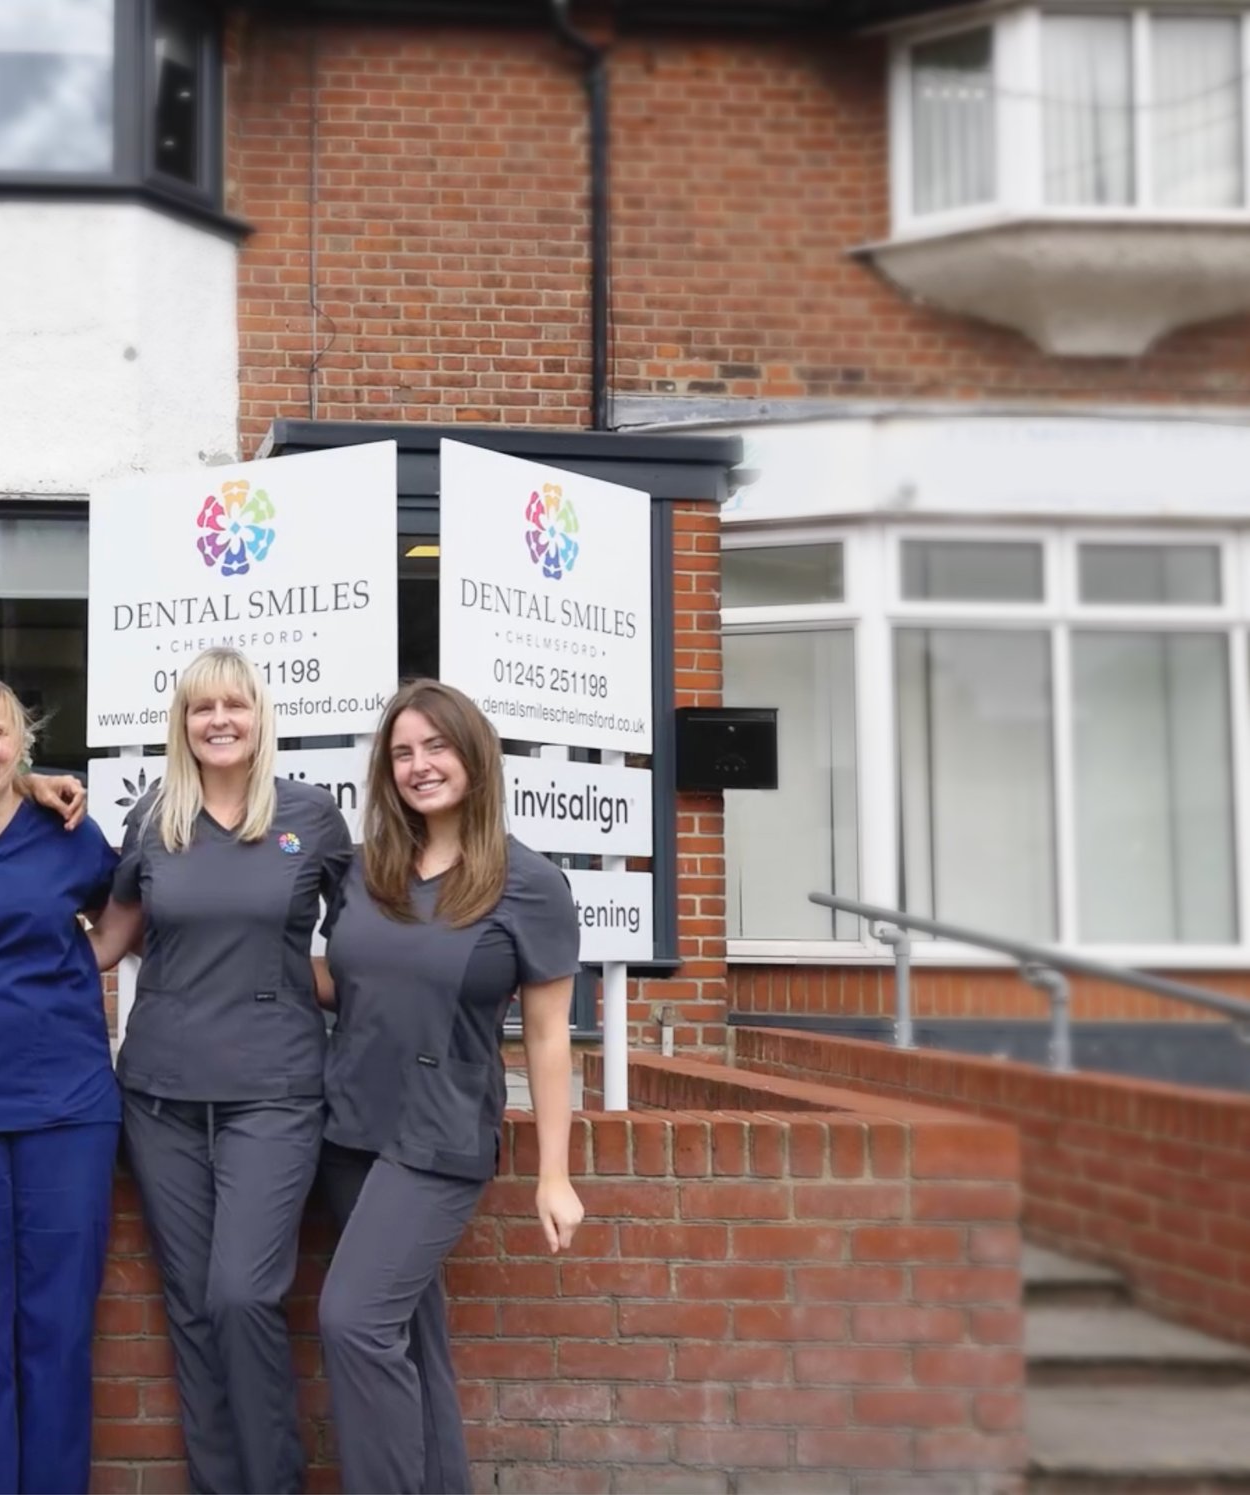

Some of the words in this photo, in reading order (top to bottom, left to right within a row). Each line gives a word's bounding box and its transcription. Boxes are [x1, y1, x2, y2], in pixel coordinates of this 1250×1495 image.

[113, 594, 240, 631] DENTAL
[248, 580, 370, 619] SMILES
[461, 578, 556, 624] DENTAL
[561, 599, 636, 638] SMILES
[506, 630, 597, 658] CHELMSFORD
[254, 658, 321, 685] 1198
[493, 658, 545, 689] 01245
[549, 667, 608, 698] 251198
[514, 778, 629, 834] invisalign
